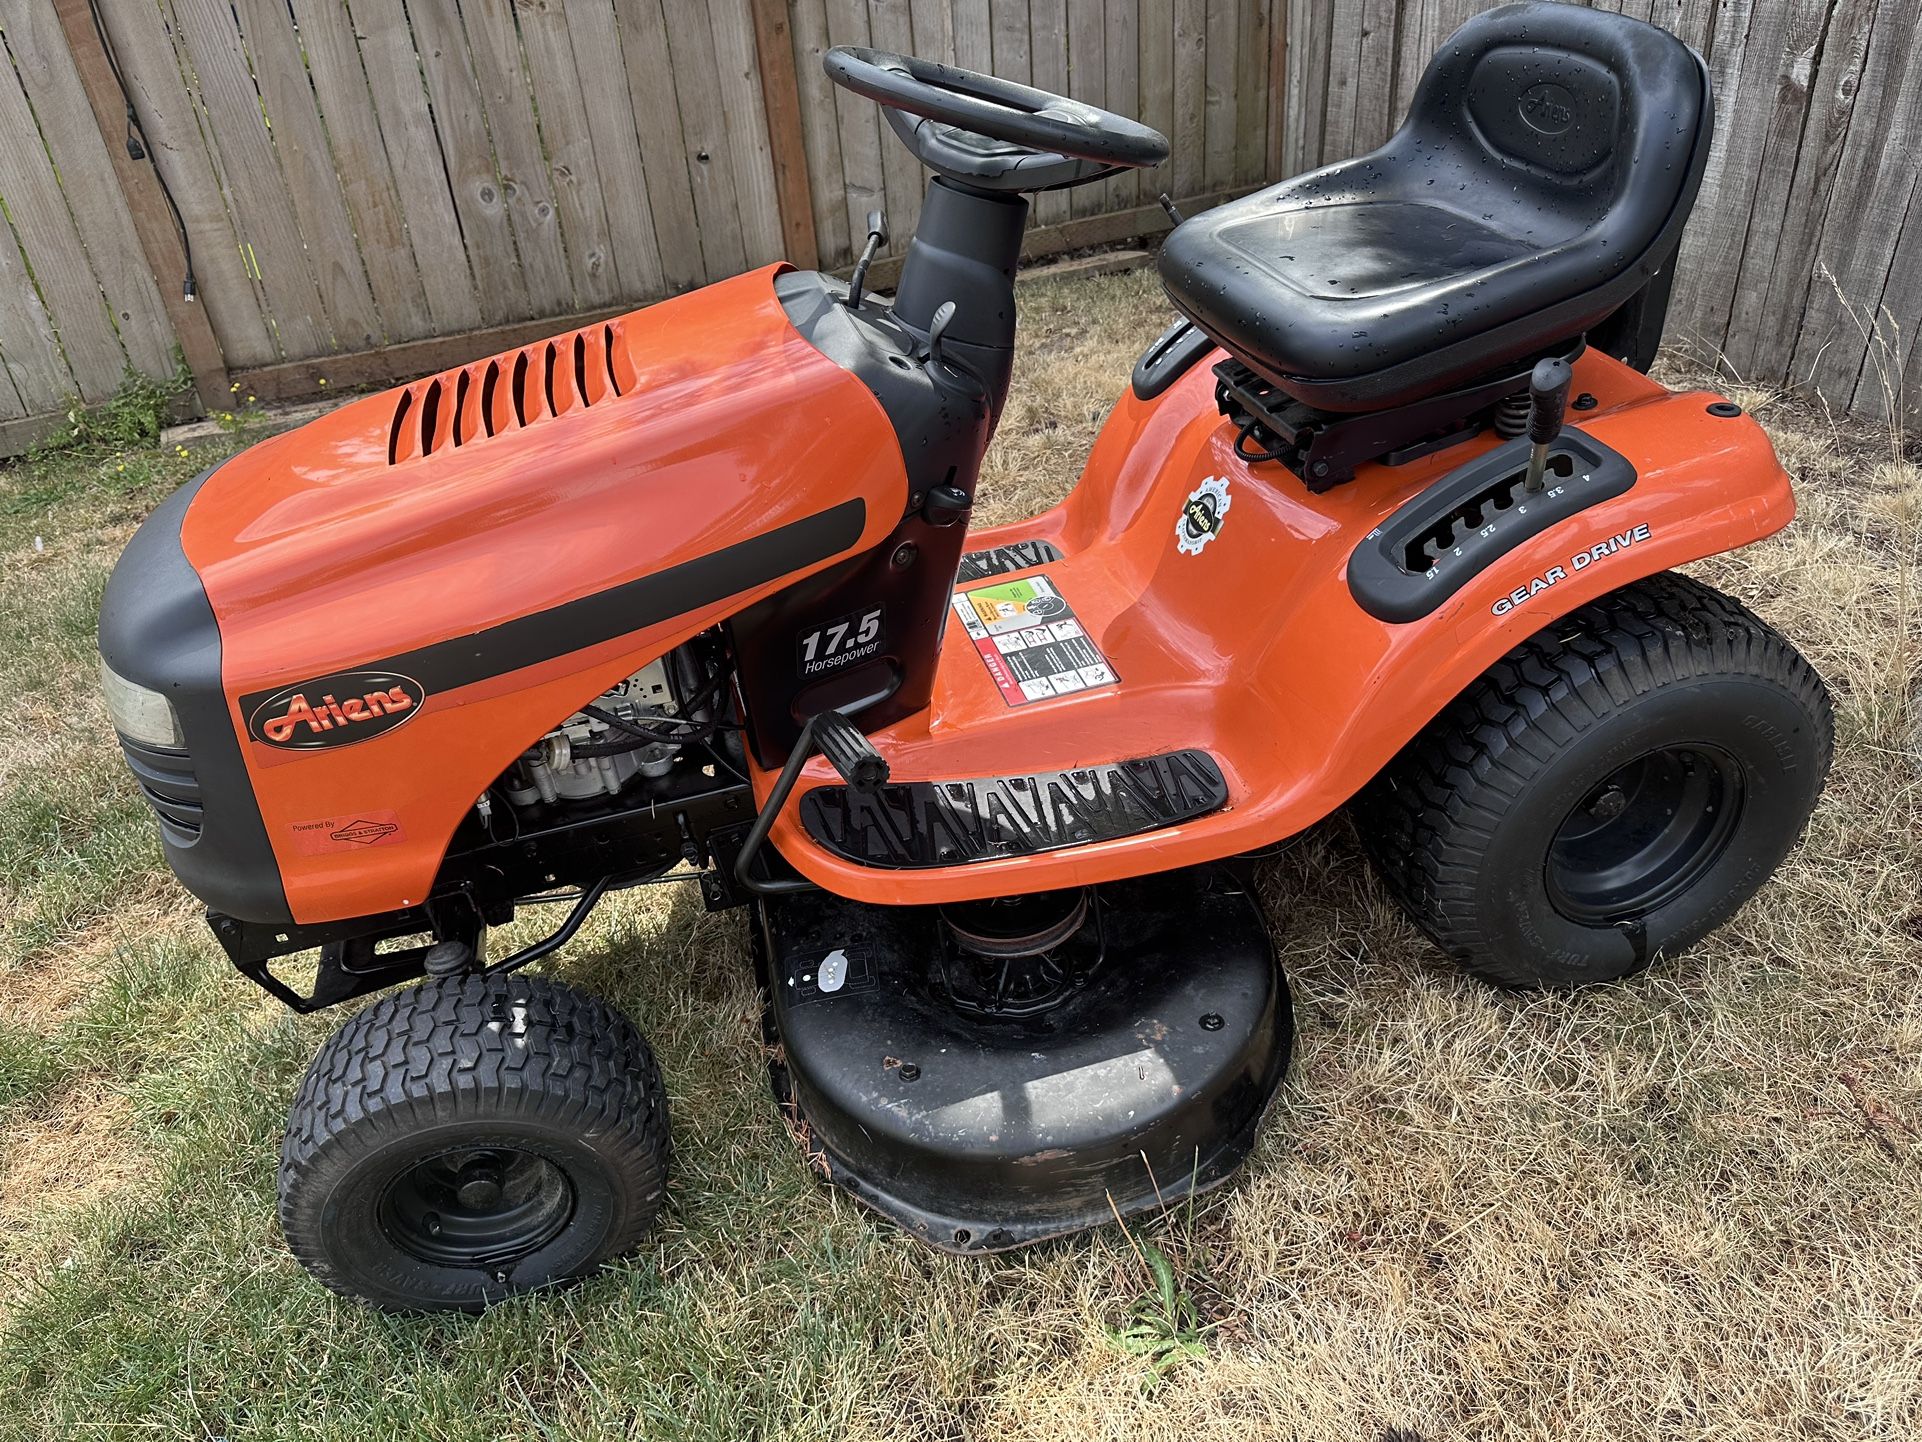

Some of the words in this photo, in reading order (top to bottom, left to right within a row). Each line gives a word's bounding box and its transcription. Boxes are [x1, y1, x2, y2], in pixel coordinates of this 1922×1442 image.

[1582, 474, 1590, 482] 4
[1547, 486, 1564, 499] 3.5
[1518, 505, 1527, 514] 3
[1189, 504, 1211, 532] Ariens
[1480, 524, 1496, 538] 2.5
[1453, 547, 1463, 557] 2
[1491, 566, 1567, 616] GEAR
[1570, 523, 1651, 571] DRIVE
[803, 609, 881, 662] 17.5
[805, 641, 880, 674] Horsepower
[983, 653, 1005, 682] DANGER
[263, 685, 413, 742] Ariens
[293, 822, 323, 832] Powered
[325, 821, 335, 829] By
[364, 826, 394, 835] STRATTON
